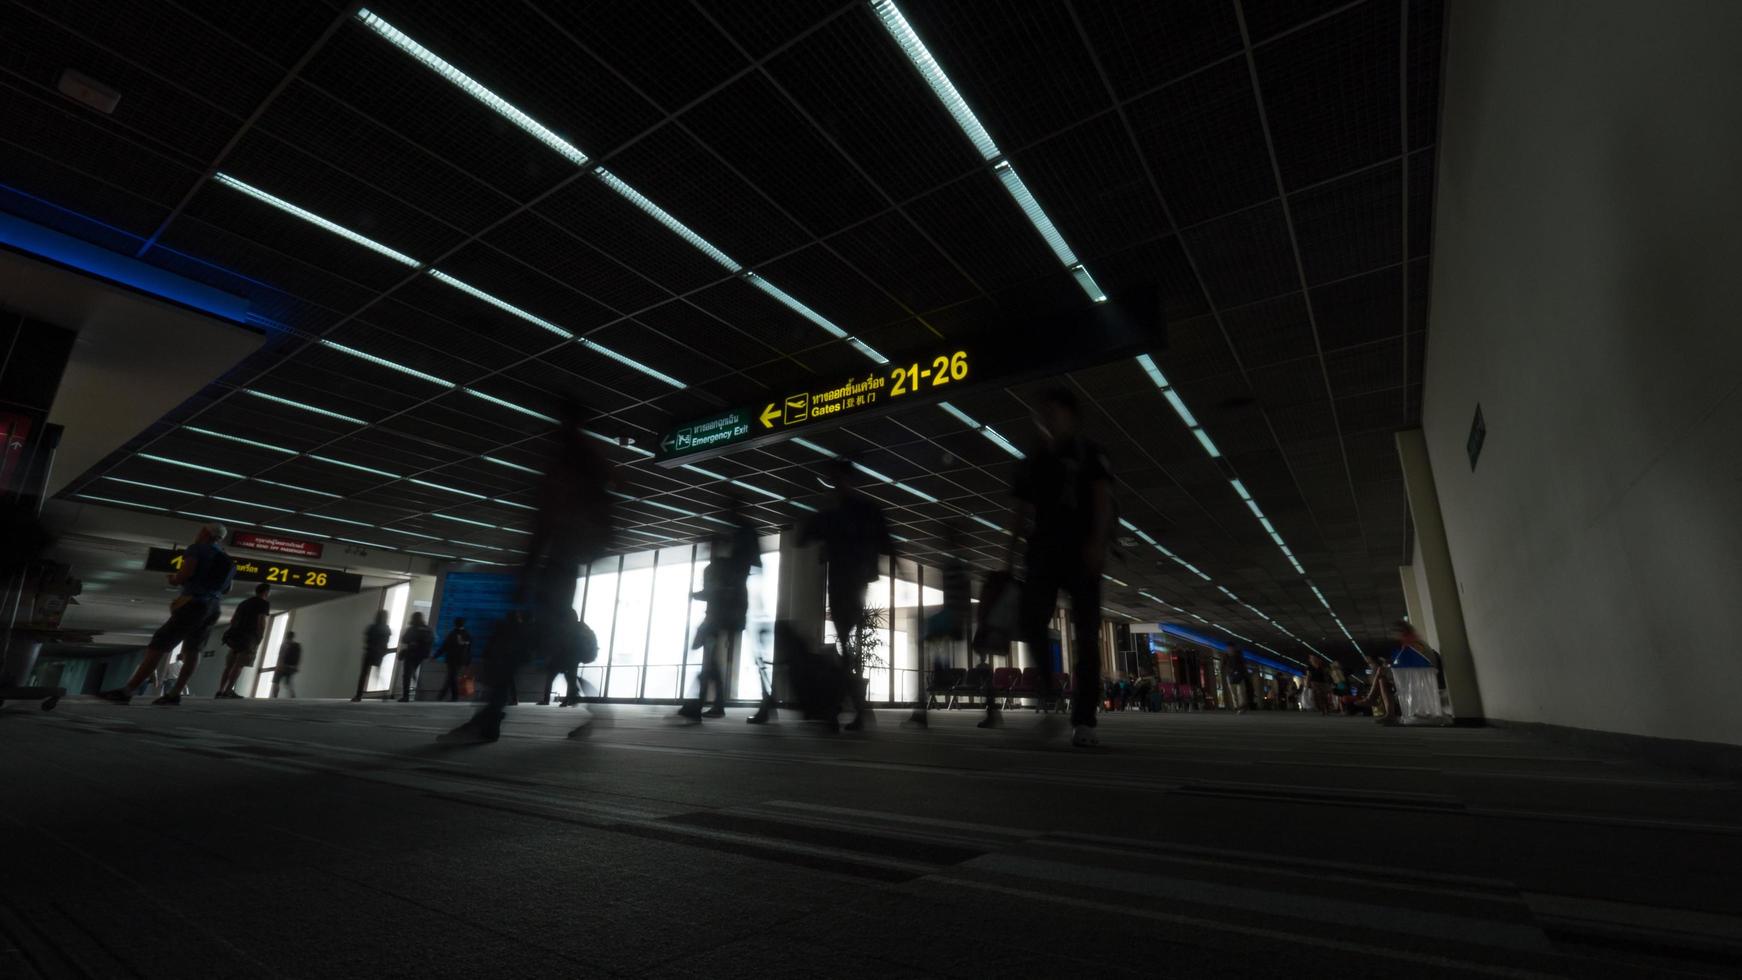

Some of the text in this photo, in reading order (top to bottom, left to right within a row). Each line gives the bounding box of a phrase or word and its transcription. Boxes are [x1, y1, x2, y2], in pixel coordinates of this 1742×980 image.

[890, 350, 968, 397] 21-26
[811, 402, 841, 417] Gates
[691, 424, 749, 447] Emergency Exit
[266, 566, 289, 583] 21
[304, 571, 328, 587] 26
